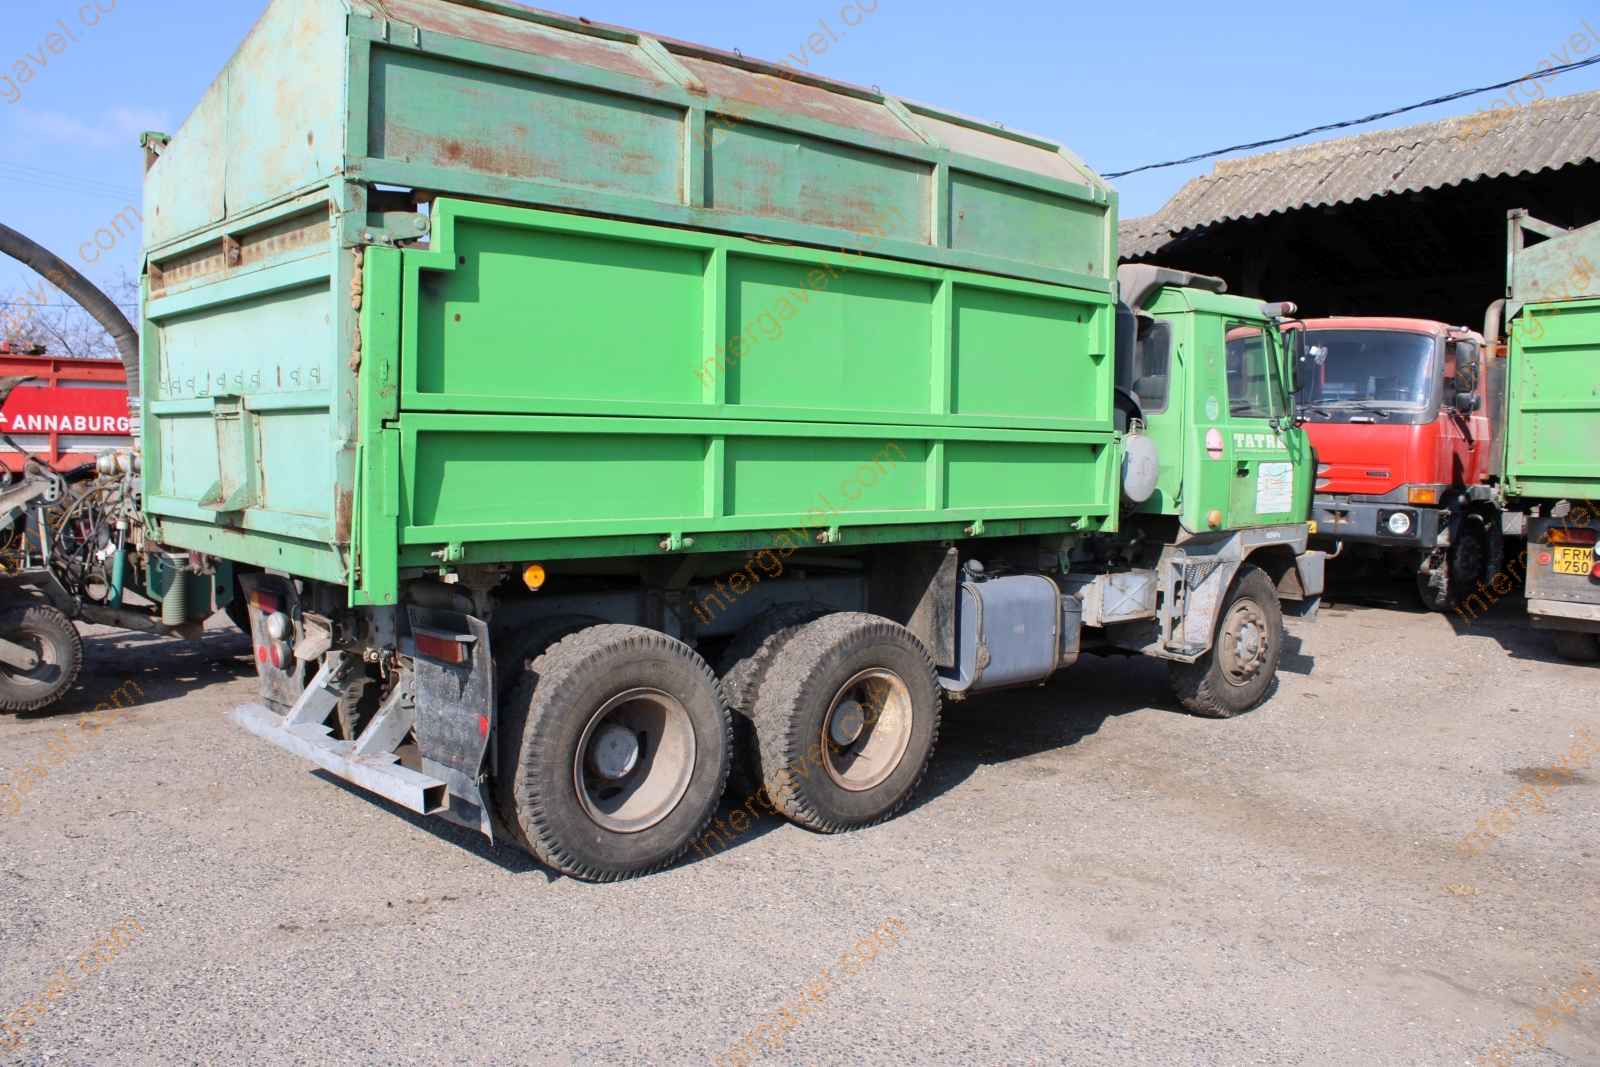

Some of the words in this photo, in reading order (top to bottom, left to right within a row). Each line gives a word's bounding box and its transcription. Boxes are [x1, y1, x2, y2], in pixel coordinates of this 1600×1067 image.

[12, 414, 129, 432] ANNABURG
[1233, 432, 1287, 449] TATRA
[1562, 548, 1592, 562] FRM
[1564, 560, 1589, 574] 750
